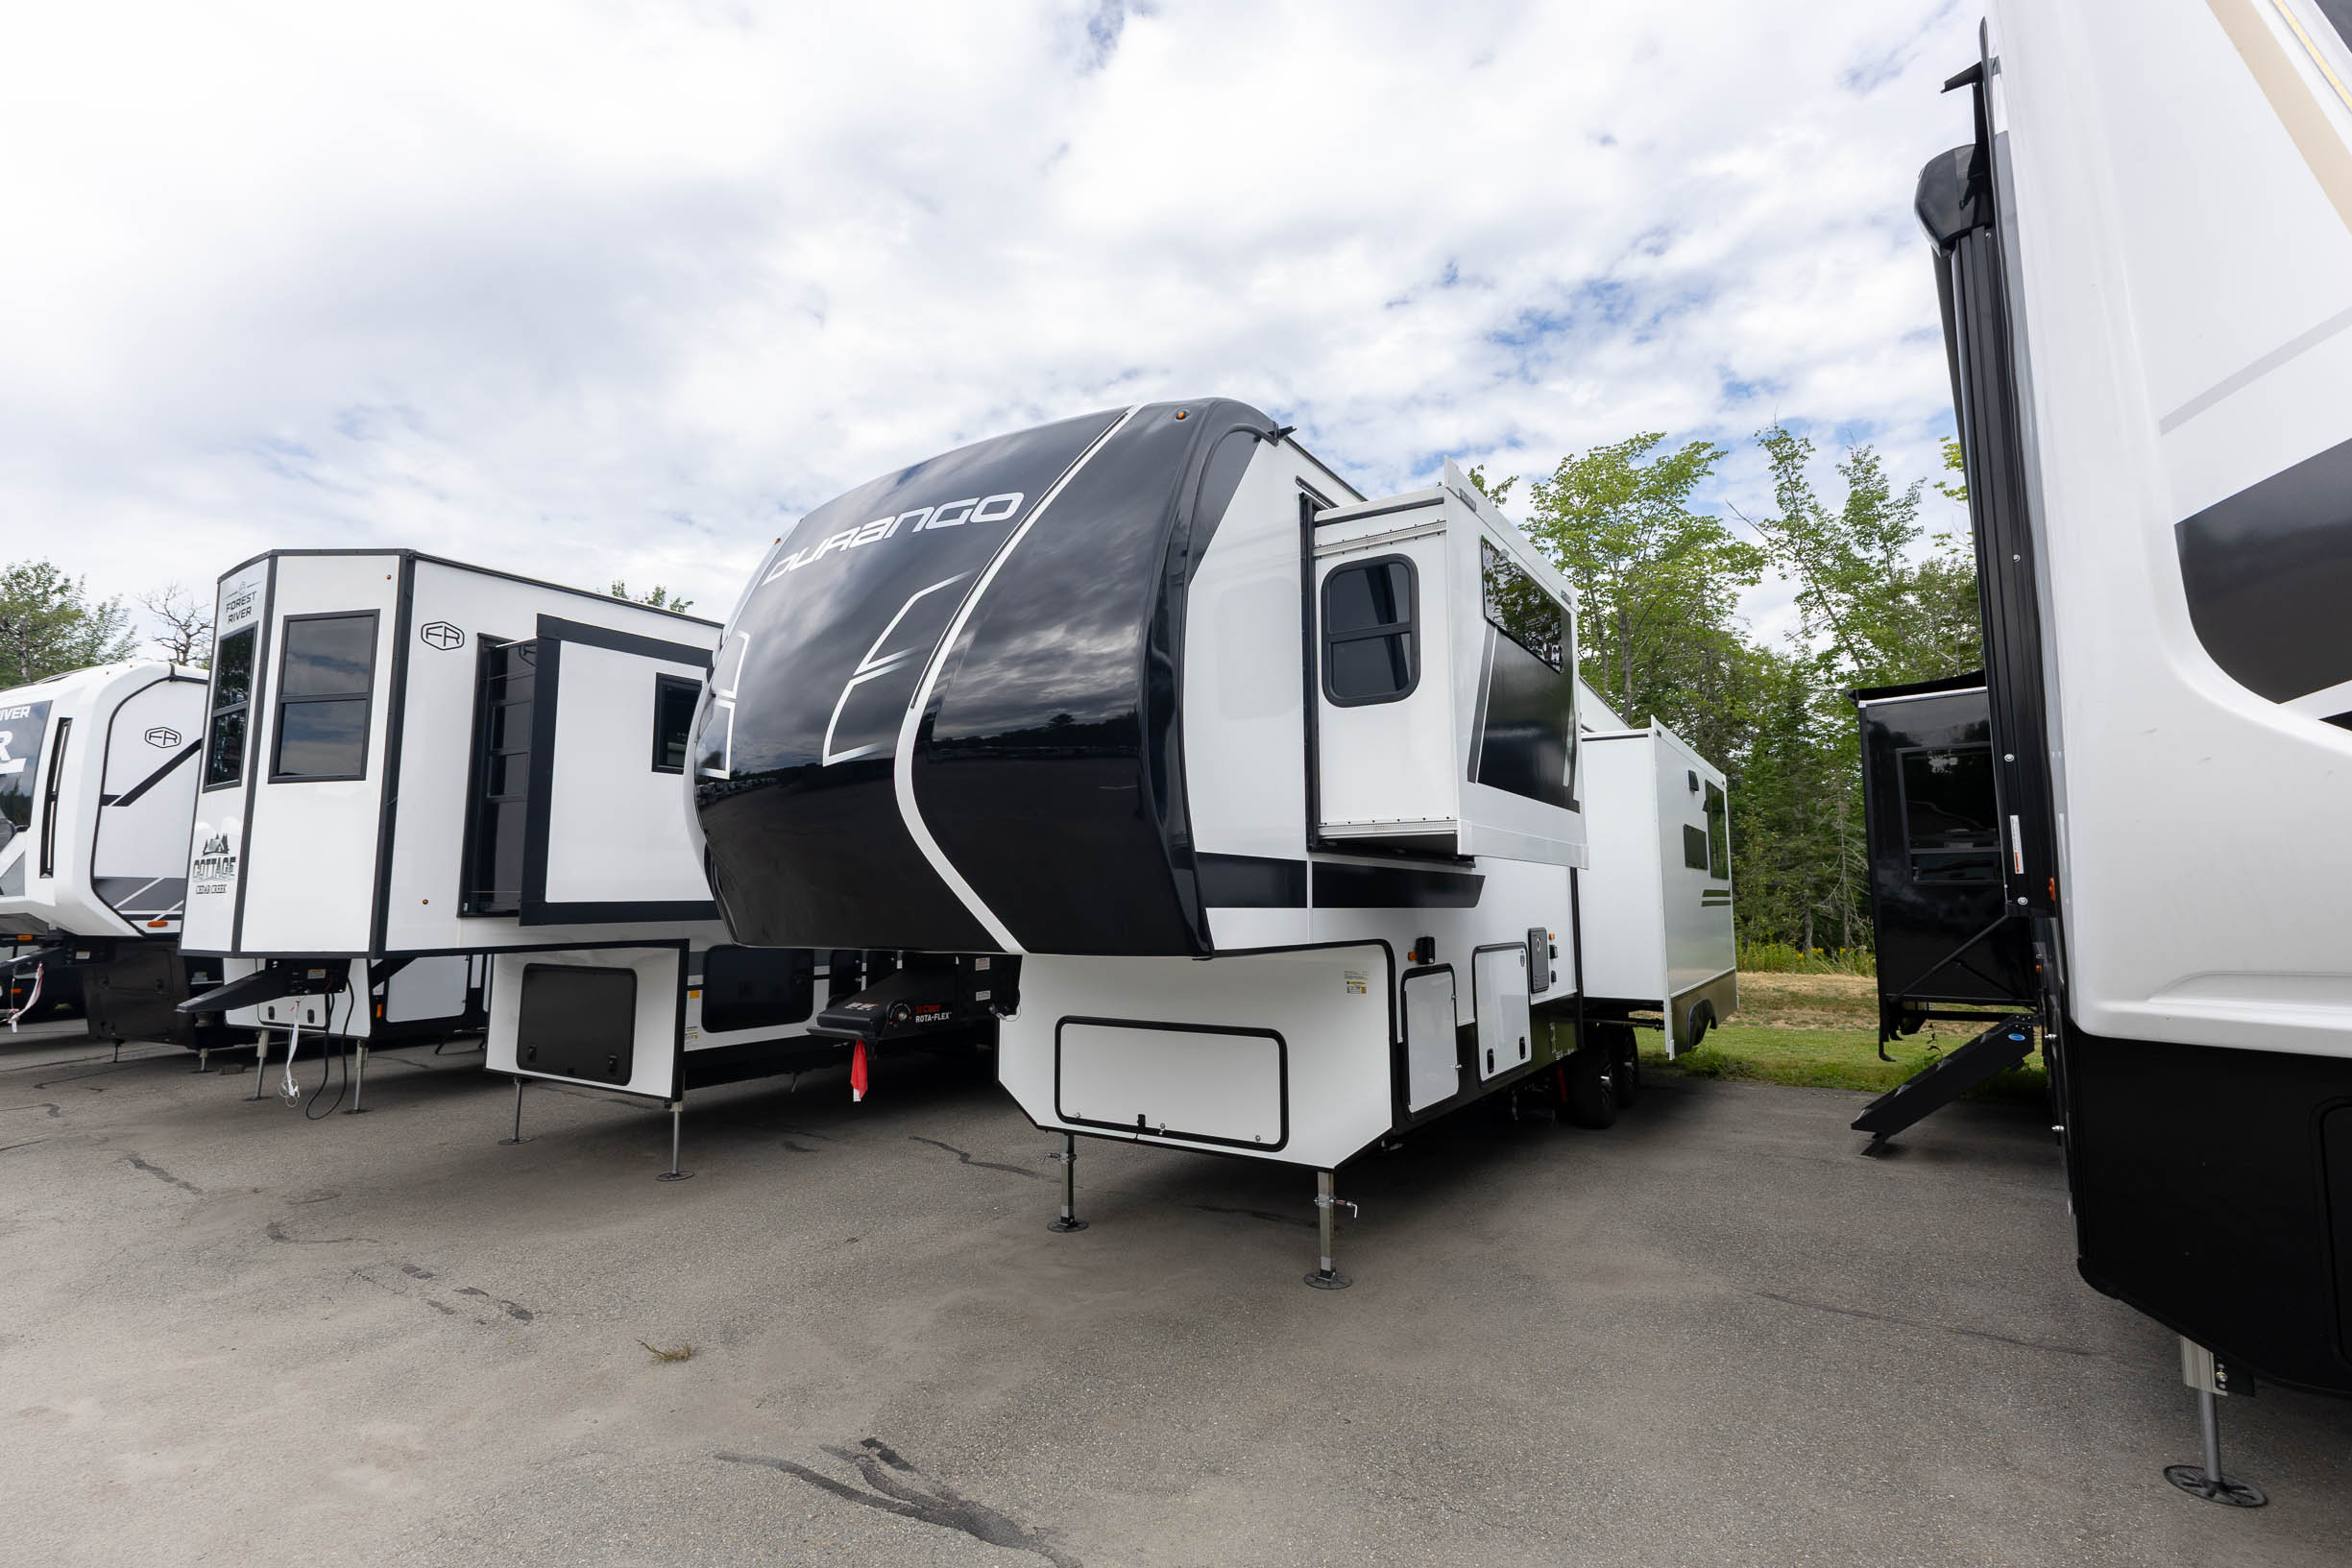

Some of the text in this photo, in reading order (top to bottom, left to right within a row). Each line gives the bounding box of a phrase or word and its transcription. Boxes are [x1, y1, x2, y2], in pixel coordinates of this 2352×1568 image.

[226, 591, 257, 613] FOREST
[228, 606, 253, 624] RIVER
[193, 856, 236, 878] COTTAGE
[915, 1013, 950, 1024] ROTA-FLEX
